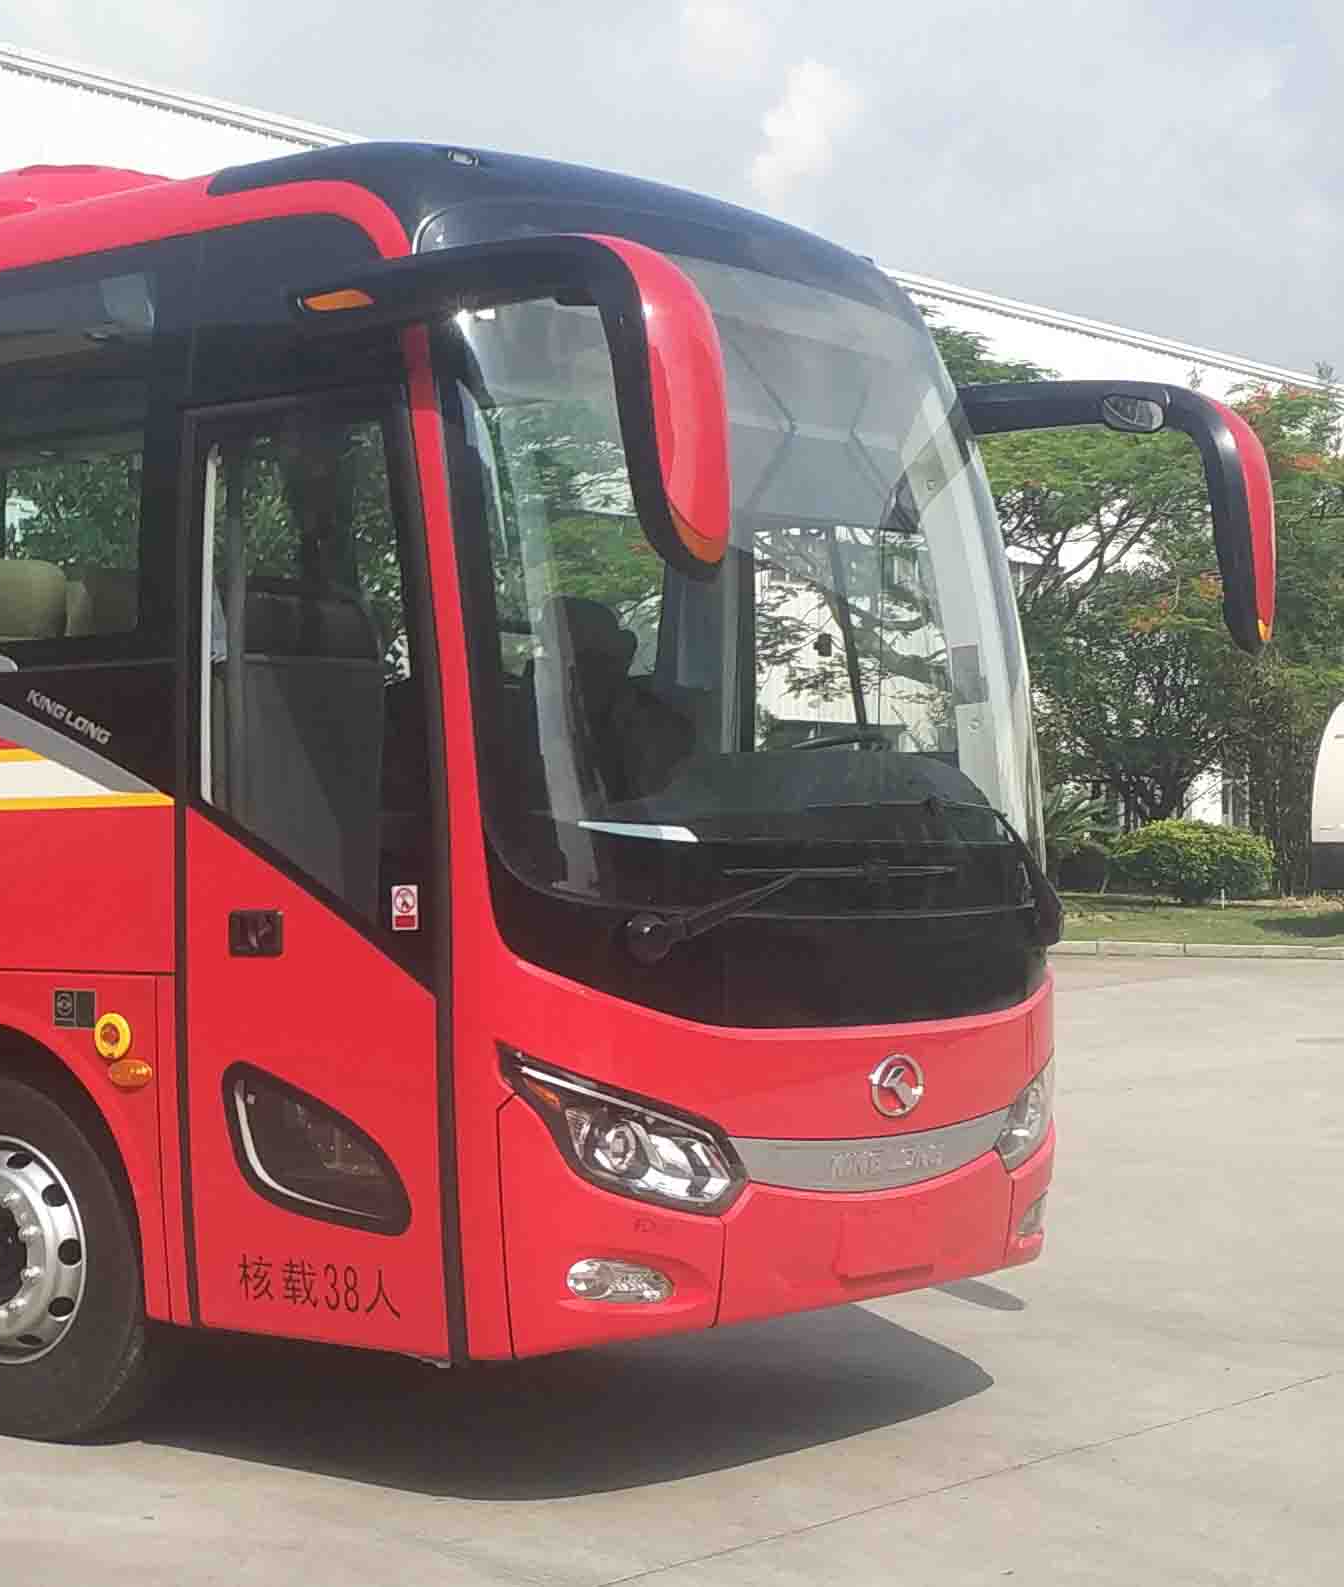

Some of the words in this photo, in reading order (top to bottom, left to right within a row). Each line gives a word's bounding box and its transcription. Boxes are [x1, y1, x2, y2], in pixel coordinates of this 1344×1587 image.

[26, 689, 67, 720] KING
[64, 710, 113, 745] LONG
[238, 1253, 401, 1320] 核载38人
